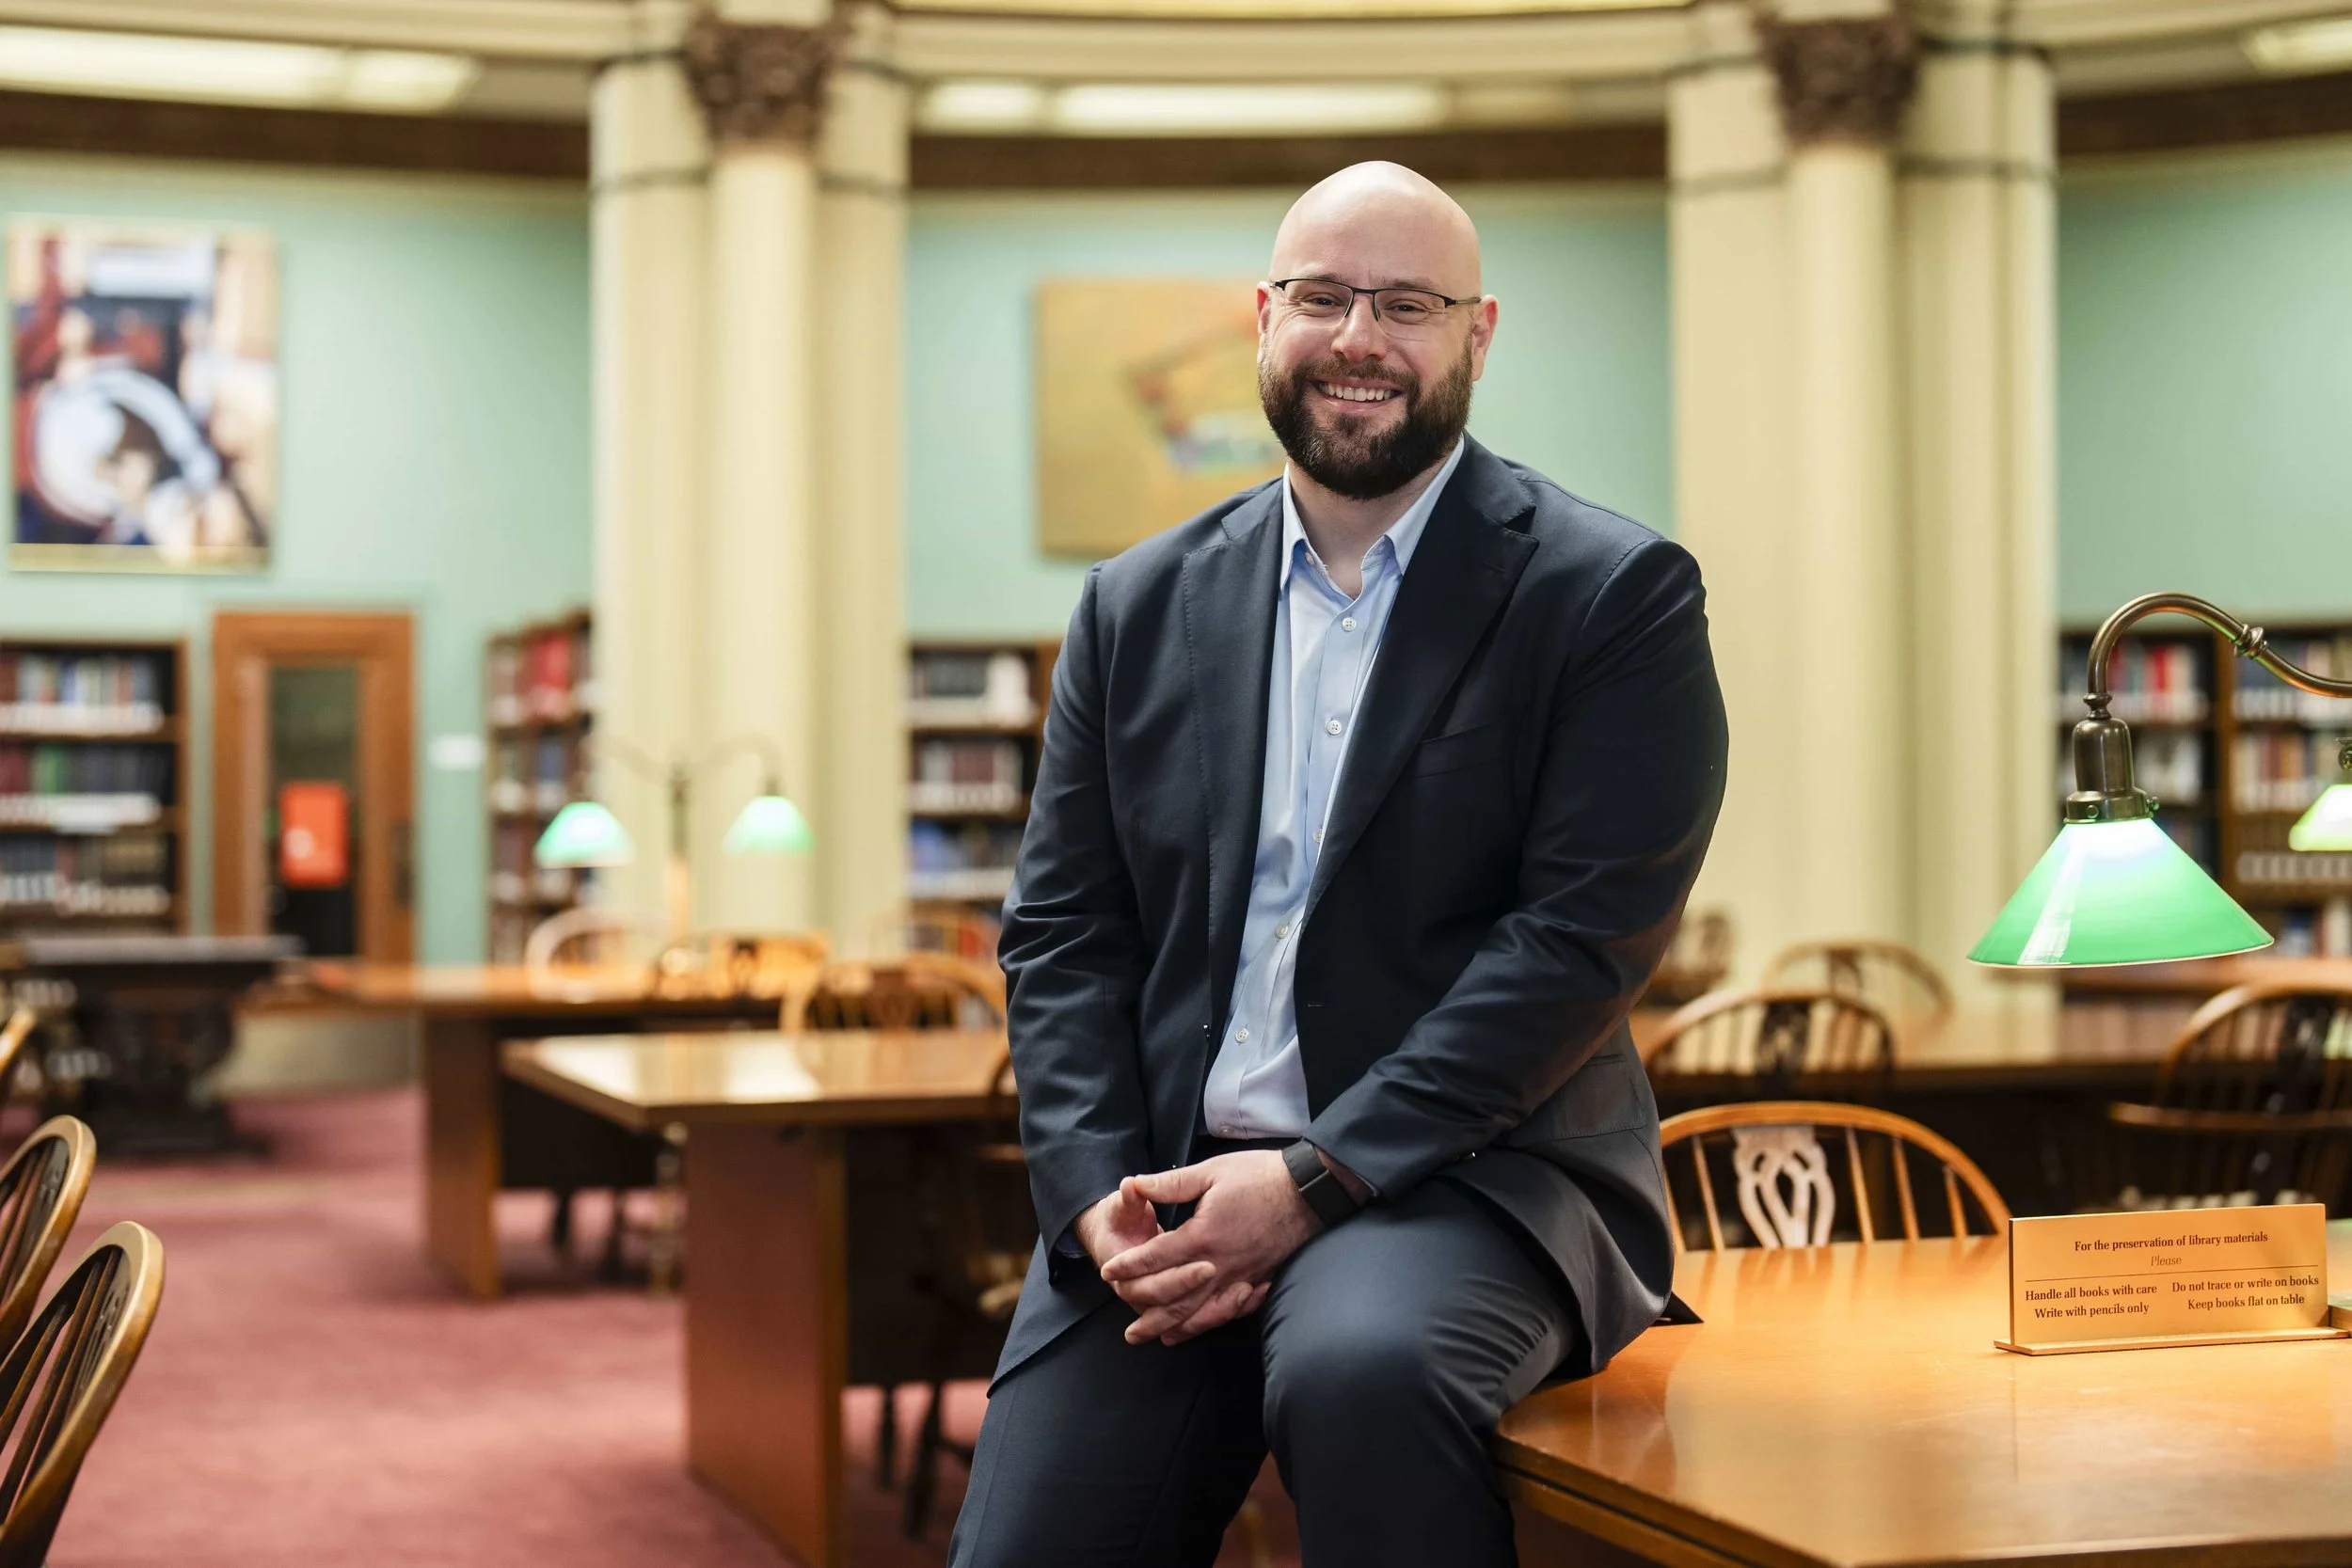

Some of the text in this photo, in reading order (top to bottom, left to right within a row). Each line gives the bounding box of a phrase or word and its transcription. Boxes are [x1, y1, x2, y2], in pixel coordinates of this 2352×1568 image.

[2074, 1232, 2268, 1251] For the preservation of library materials
[2151, 1255, 2182, 1266] Please
[2172, 1275, 2319, 1292] Do not trace or write on books
[2026, 1285, 2157, 1301] Handle all books with care
[2188, 1293, 2304, 1311] Keep books flat on table
[2035, 1303, 2149, 1319] Write with pencils only
